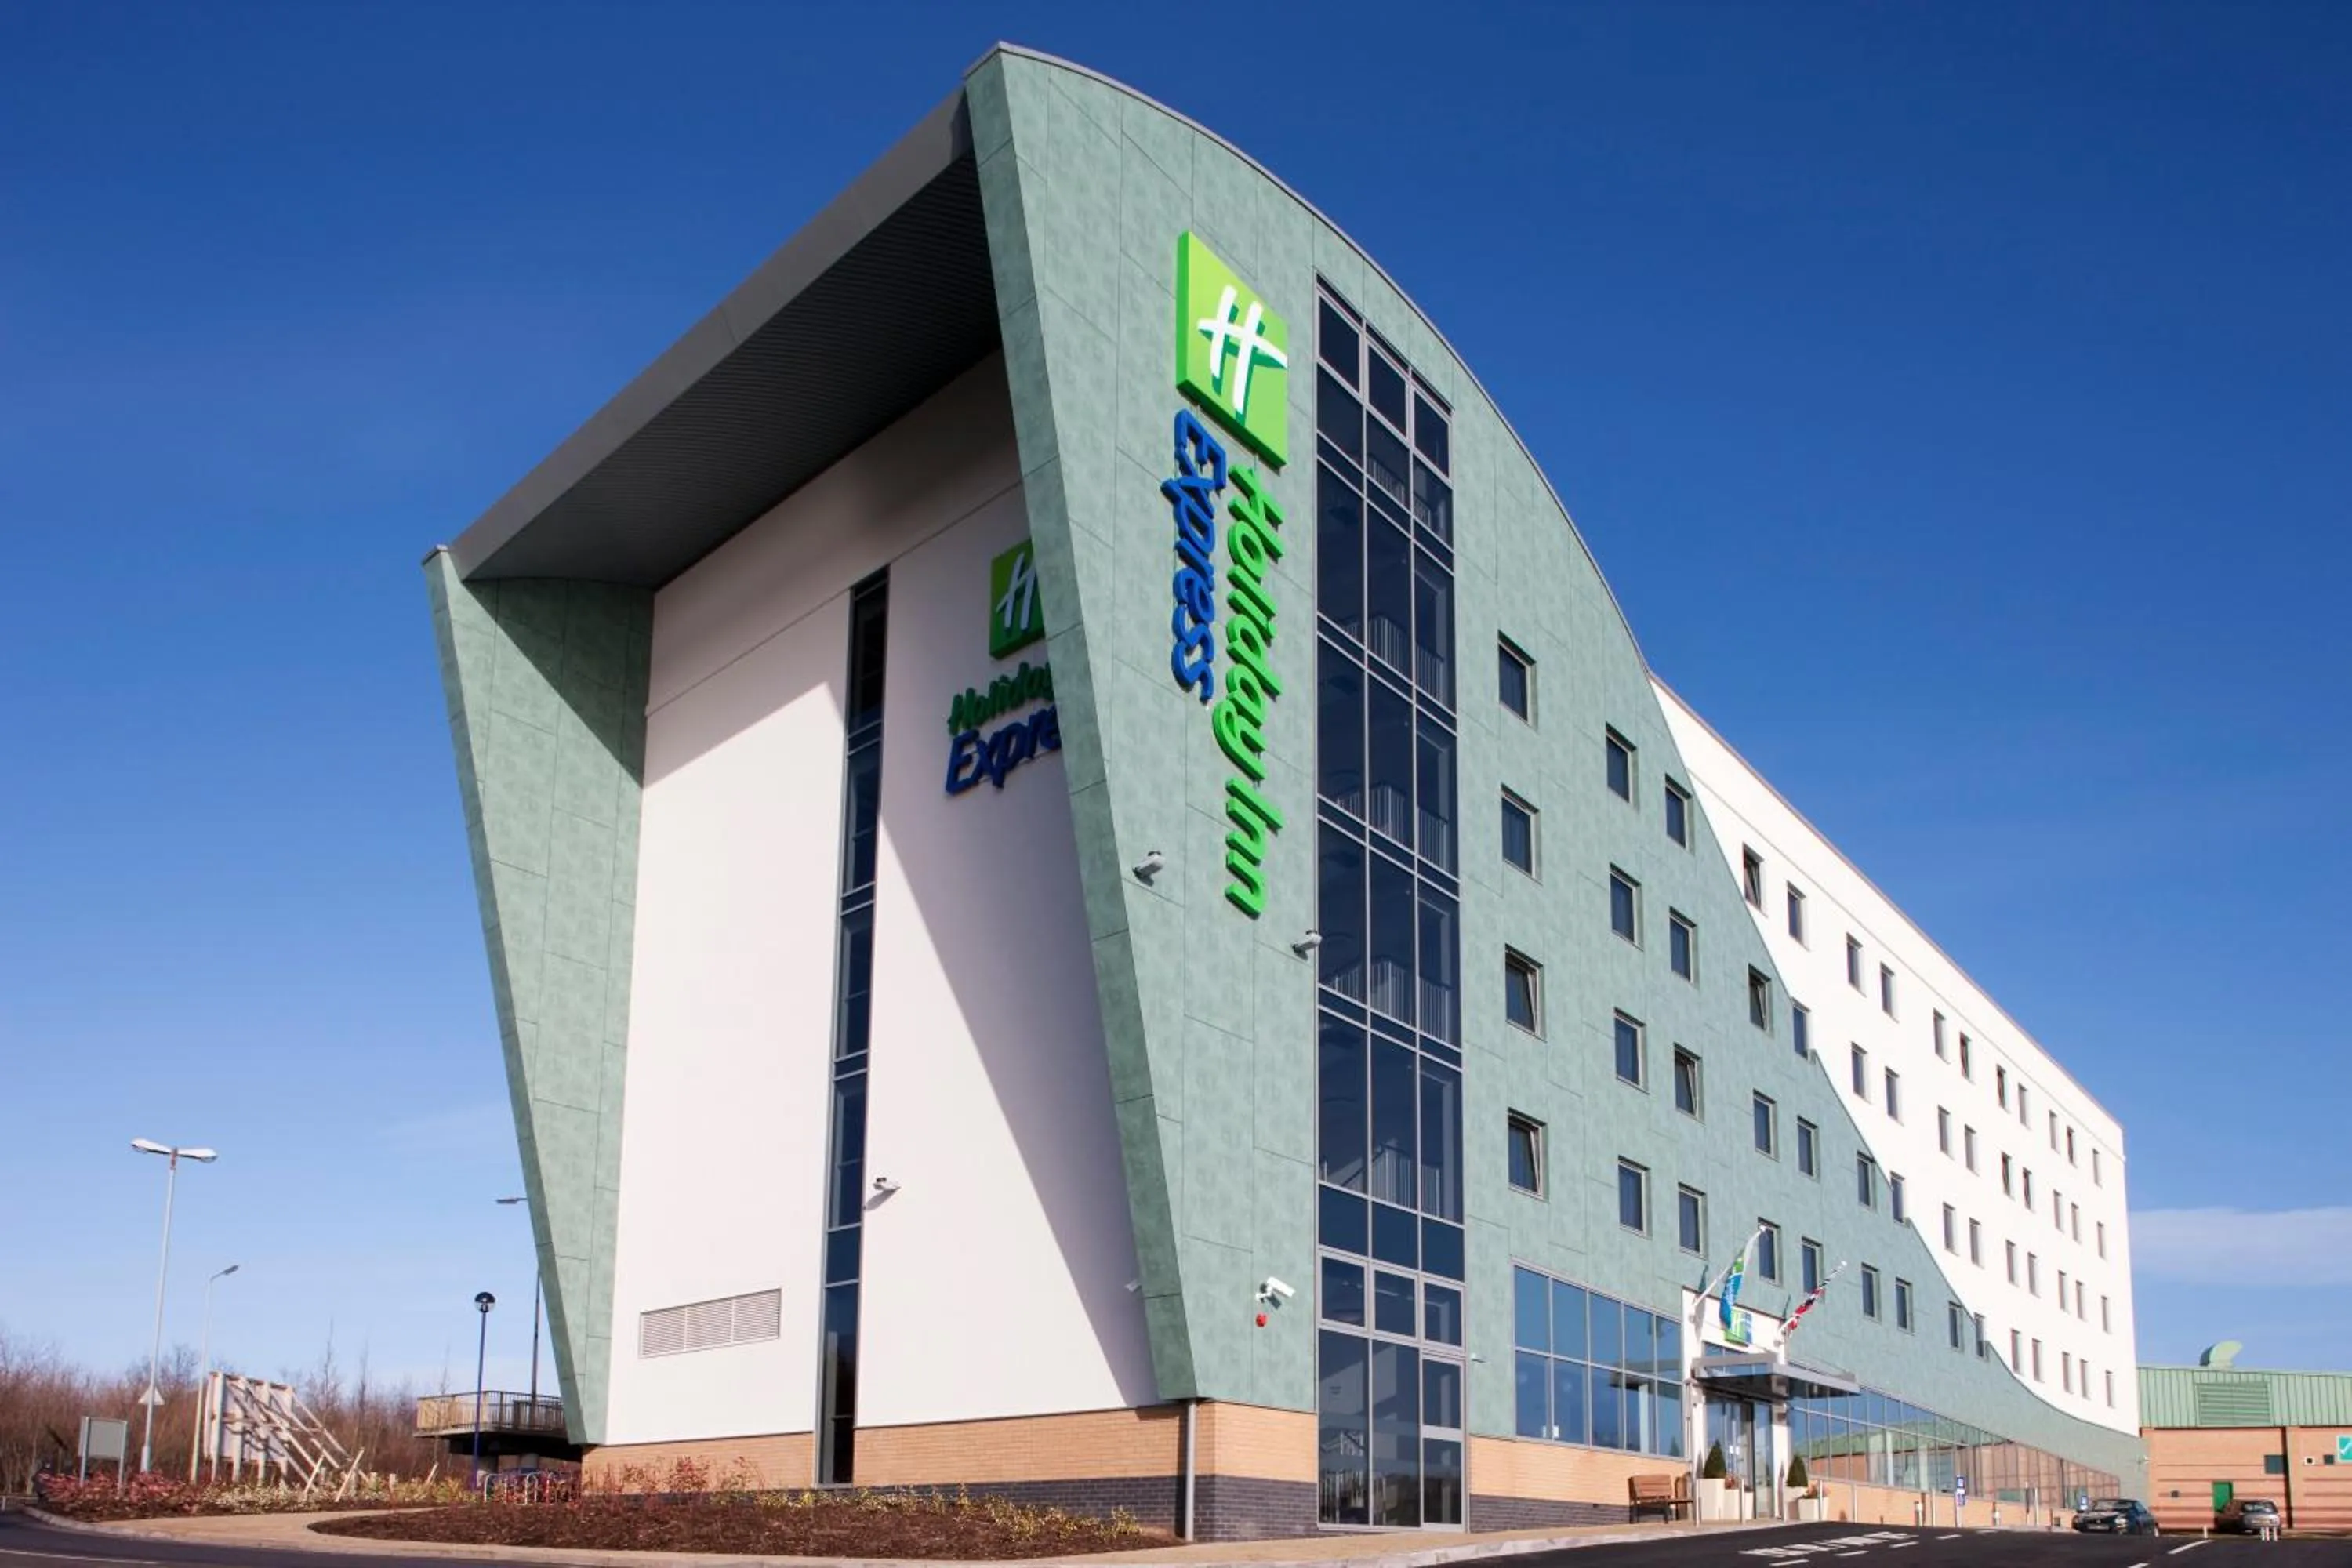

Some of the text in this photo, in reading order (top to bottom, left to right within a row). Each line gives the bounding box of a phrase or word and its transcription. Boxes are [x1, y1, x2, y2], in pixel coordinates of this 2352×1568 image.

[1161, 408, 1226, 704] Express
[1212, 465, 1283, 919] Holiday Inn
